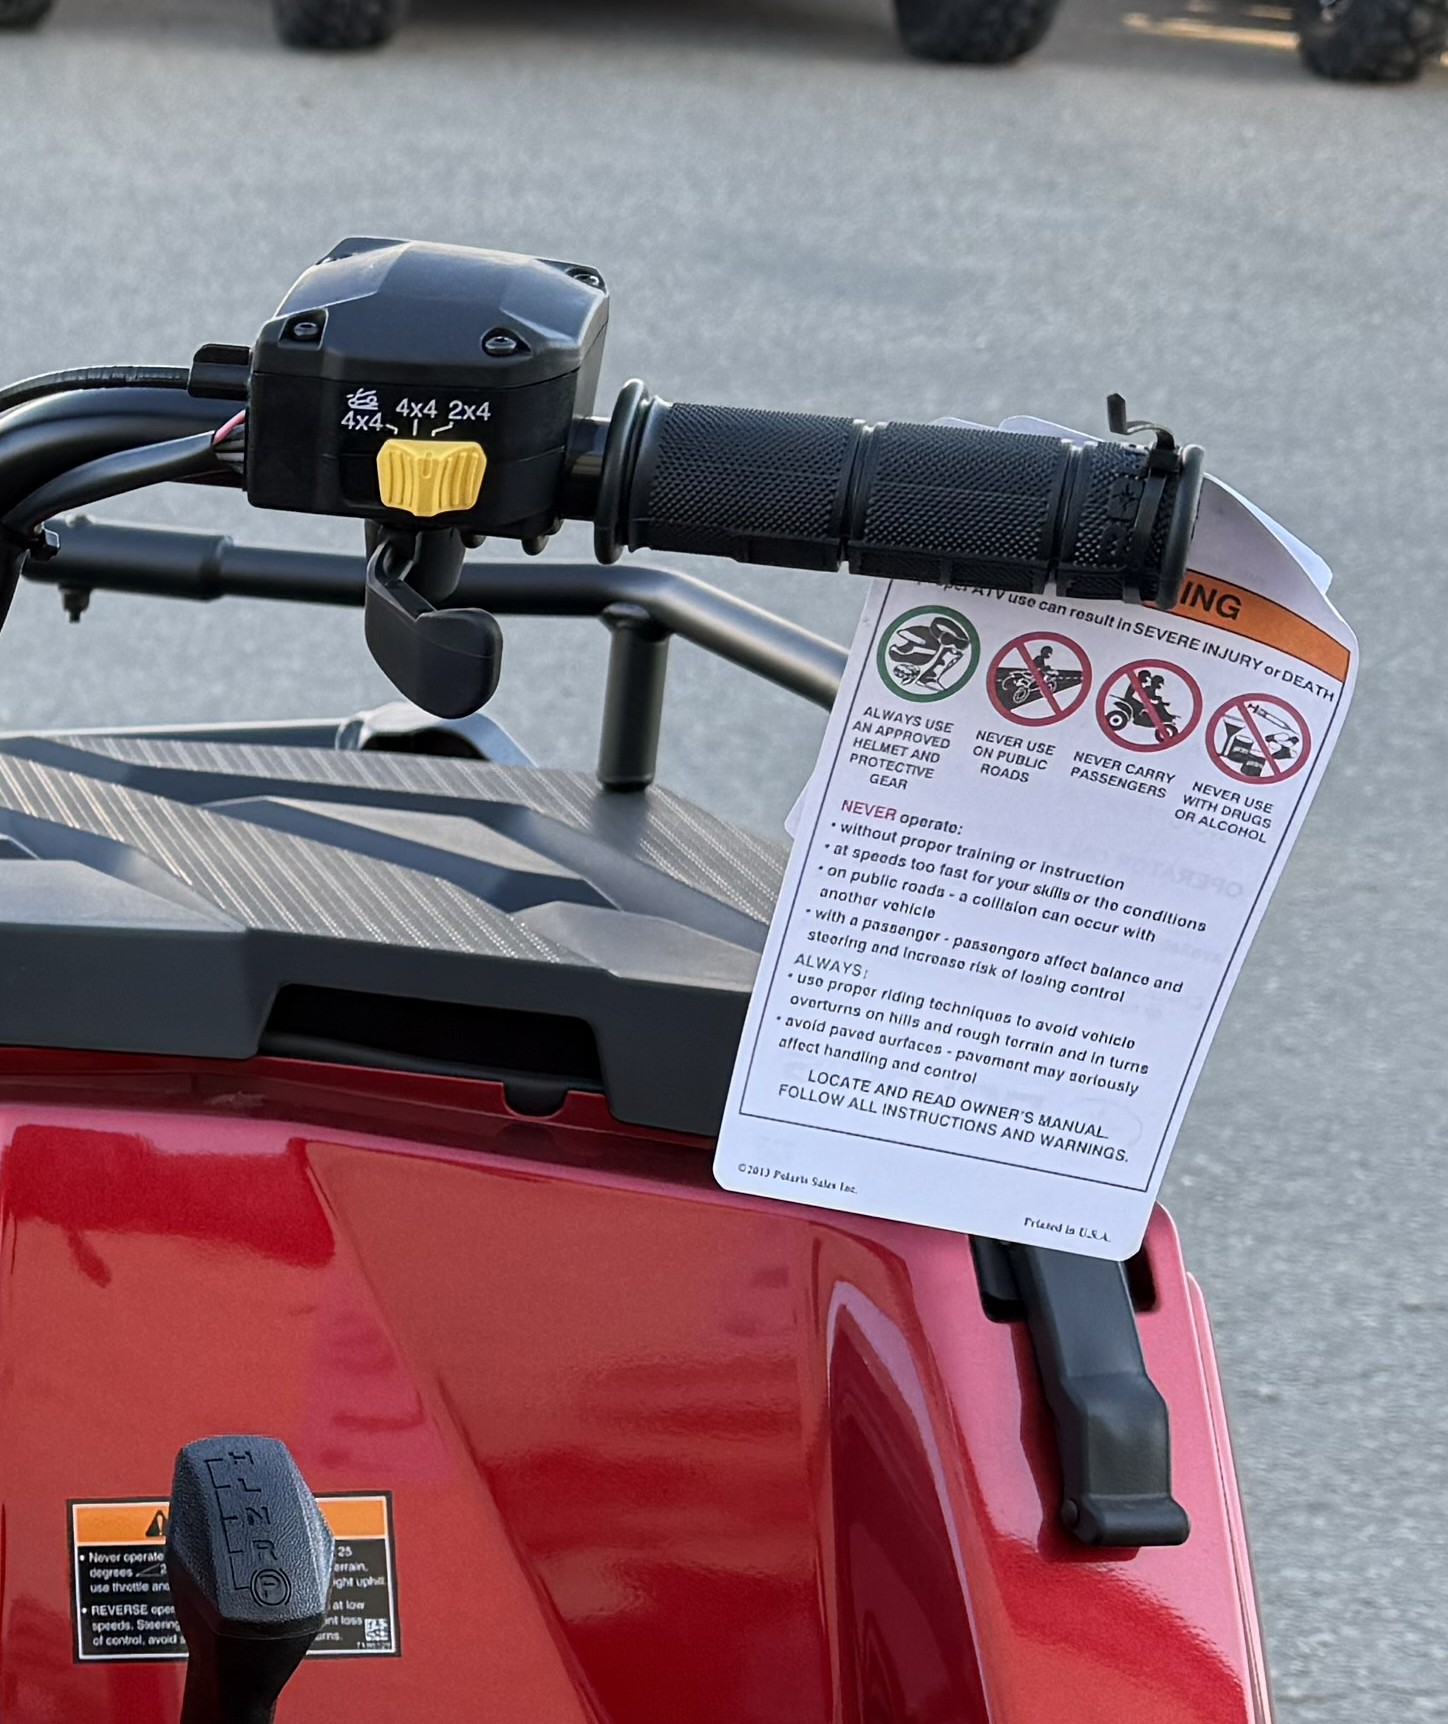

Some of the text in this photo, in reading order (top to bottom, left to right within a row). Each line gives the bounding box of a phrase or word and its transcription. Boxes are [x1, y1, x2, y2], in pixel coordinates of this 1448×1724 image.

[341, 412, 384, 432] 4x4
[395, 397, 492, 421] 4x4 2x4
[1007, 592, 1036, 608] use
[1038, 600, 1067, 616] can
[1069, 607, 1116, 629] result
[1116, 617, 1132, 633] in
[1132, 622, 1202, 651] SEVERE
[1202, 641, 1264, 670] INJURY
[1263, 665, 1282, 679] or
[1281, 670, 1336, 702] DEATH
[862, 706, 954, 733] ALWAYS USE
[851, 720, 950, 749] AN APPROVED
[975, 729, 1056, 755] NEVER USE
[852, 736, 940, 763] HELMET AND
[972, 745, 1047, 770] ON PUBLIC
[849, 752, 935, 779] PROTECTIVE
[979, 763, 1029, 782] ROADS
[1073, 751, 1176, 784] NEVER CARRY
[869, 773, 908, 790] GEAR
[1070, 766, 1166, 798] PASSENGERS
[1187, 781, 1273, 814] NEVER USE
[841, 799, 963, 835] NEVER operate:
[1177, 794, 1271, 829] WITH DRUGS
[1174, 808, 1269, 843] OR ALCOHOL
[840, 822, 897, 843] without
[899, 835, 952, 853] proper
[956, 844, 1015, 869] training
[1019, 859, 1037, 870] or
[1039, 861, 1124, 890] instruction
[807, 1069, 1108, 1139] LOCATE AND READ OWNER'S MANUAL.
[778, 1083, 1128, 1162] FOLLOW ALL INSTRUCTIONS AND WARNINGS.
[228, 1450, 255, 1466] H
[237, 1477, 262, 1493] L
[244, 1505, 271, 1526] N
[252, 1539, 278, 1561] R
[259, 1574, 281, 1598] P
